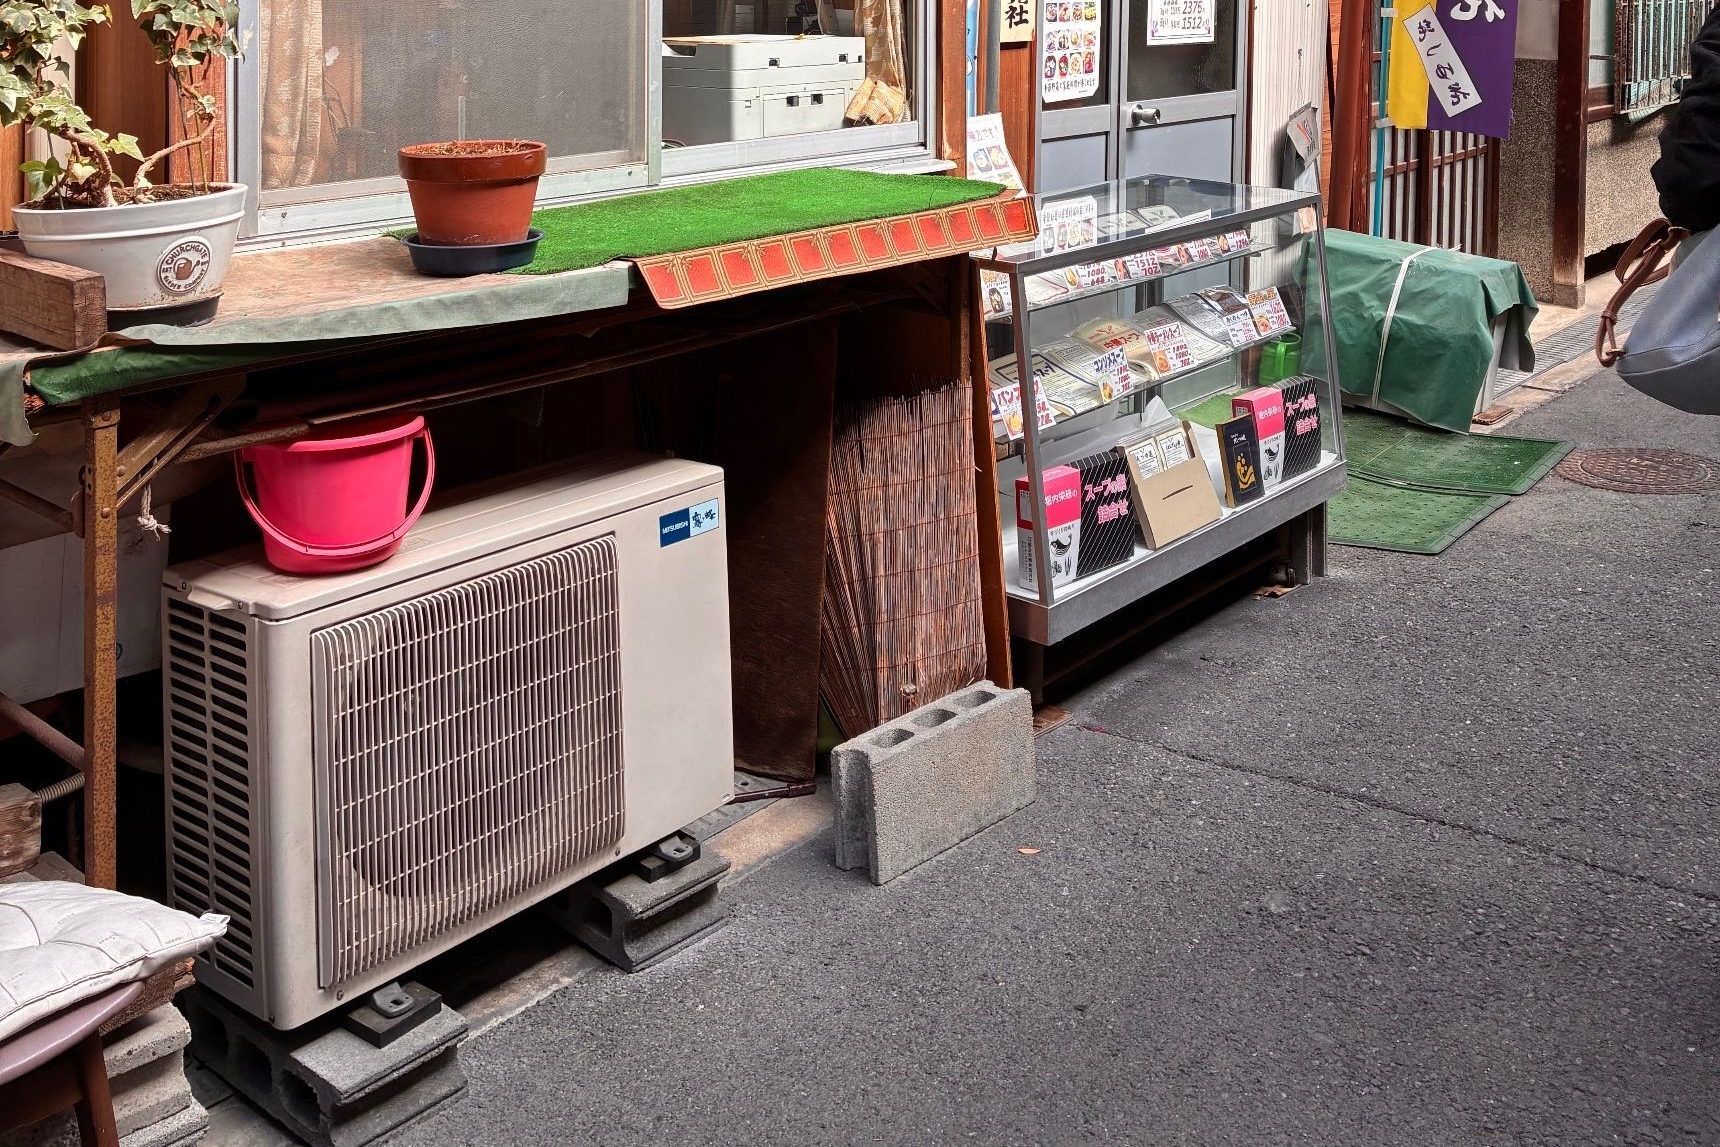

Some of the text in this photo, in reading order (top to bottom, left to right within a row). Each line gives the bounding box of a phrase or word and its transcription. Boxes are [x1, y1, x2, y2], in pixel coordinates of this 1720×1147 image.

[1182, 16, 1203, 29] 1512
[165, 243, 208, 265] CHURCHGATE
[1134, 257, 1158, 269] 1512
[1141, 266, 1161, 277] 702
[1084, 473, 1128, 502] スープの素
[1097, 498, 1129, 525] 詰合せ
[662, 520, 689, 534] MITSUBISHI
